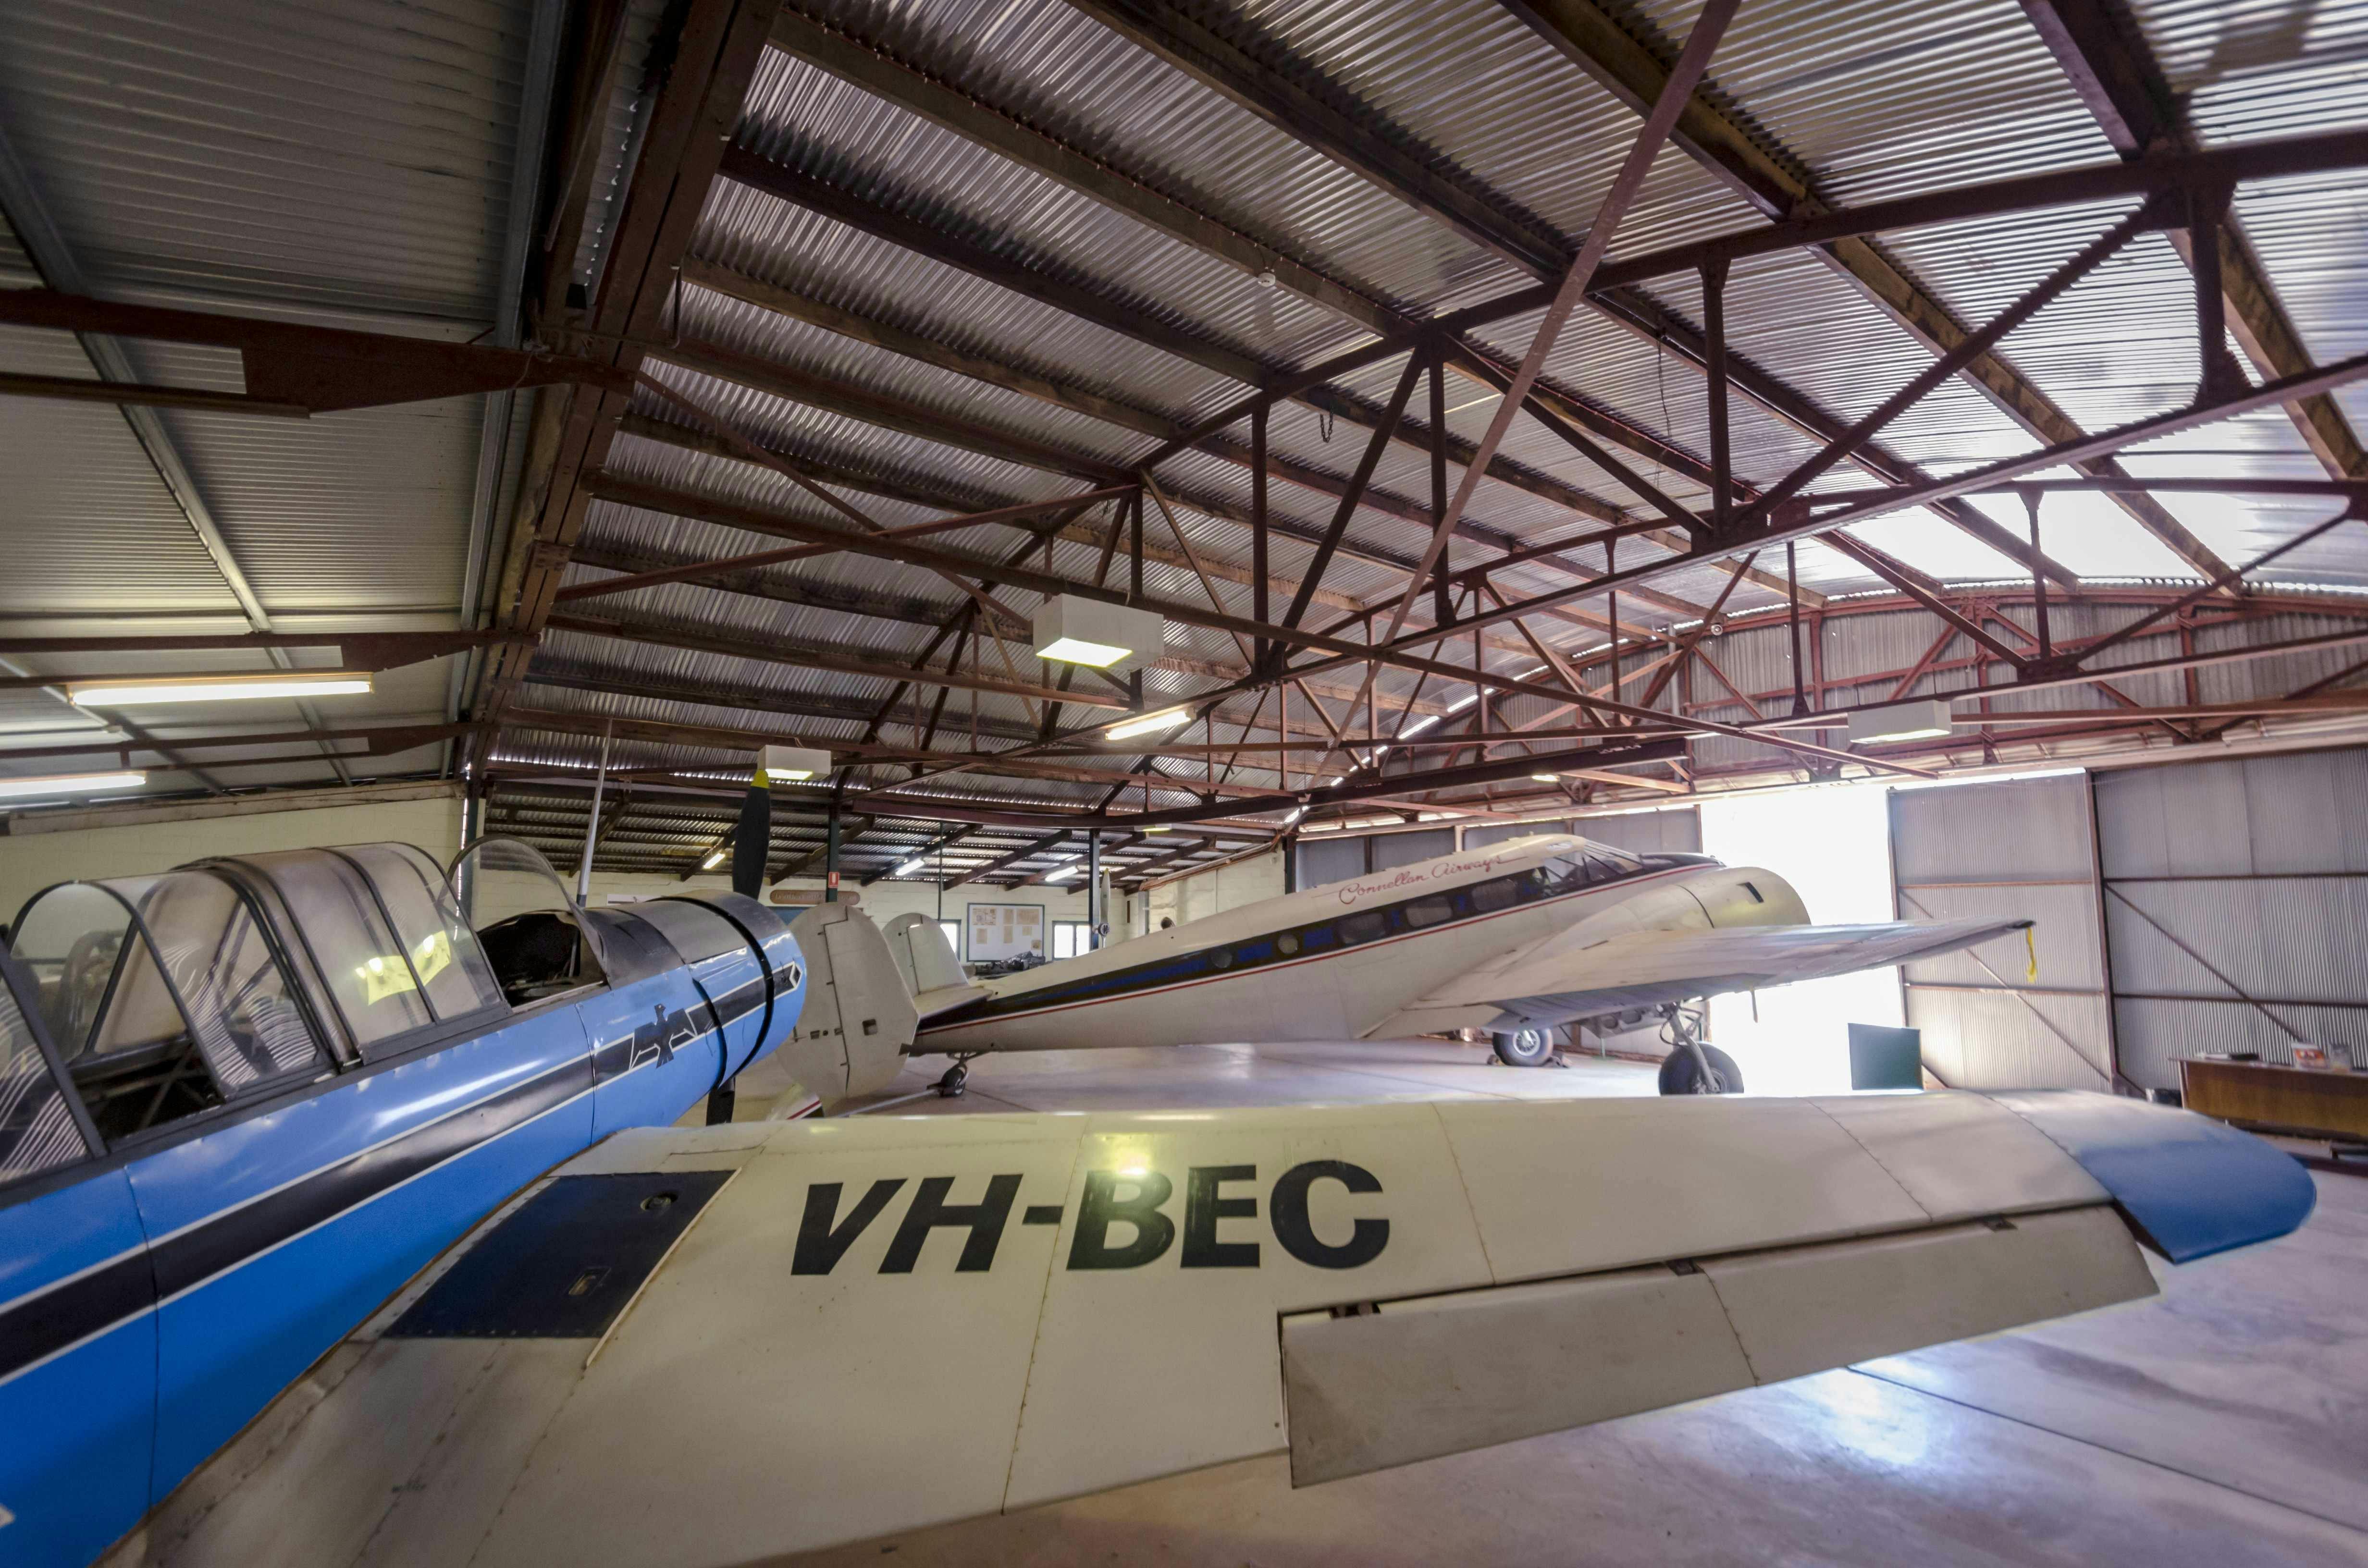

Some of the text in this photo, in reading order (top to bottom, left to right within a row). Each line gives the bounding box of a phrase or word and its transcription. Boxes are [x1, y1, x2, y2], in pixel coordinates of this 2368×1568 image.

[1338, 855, 1516, 905] Connellan Airways
[790, 1160, 1390, 1276] VH-BEC
